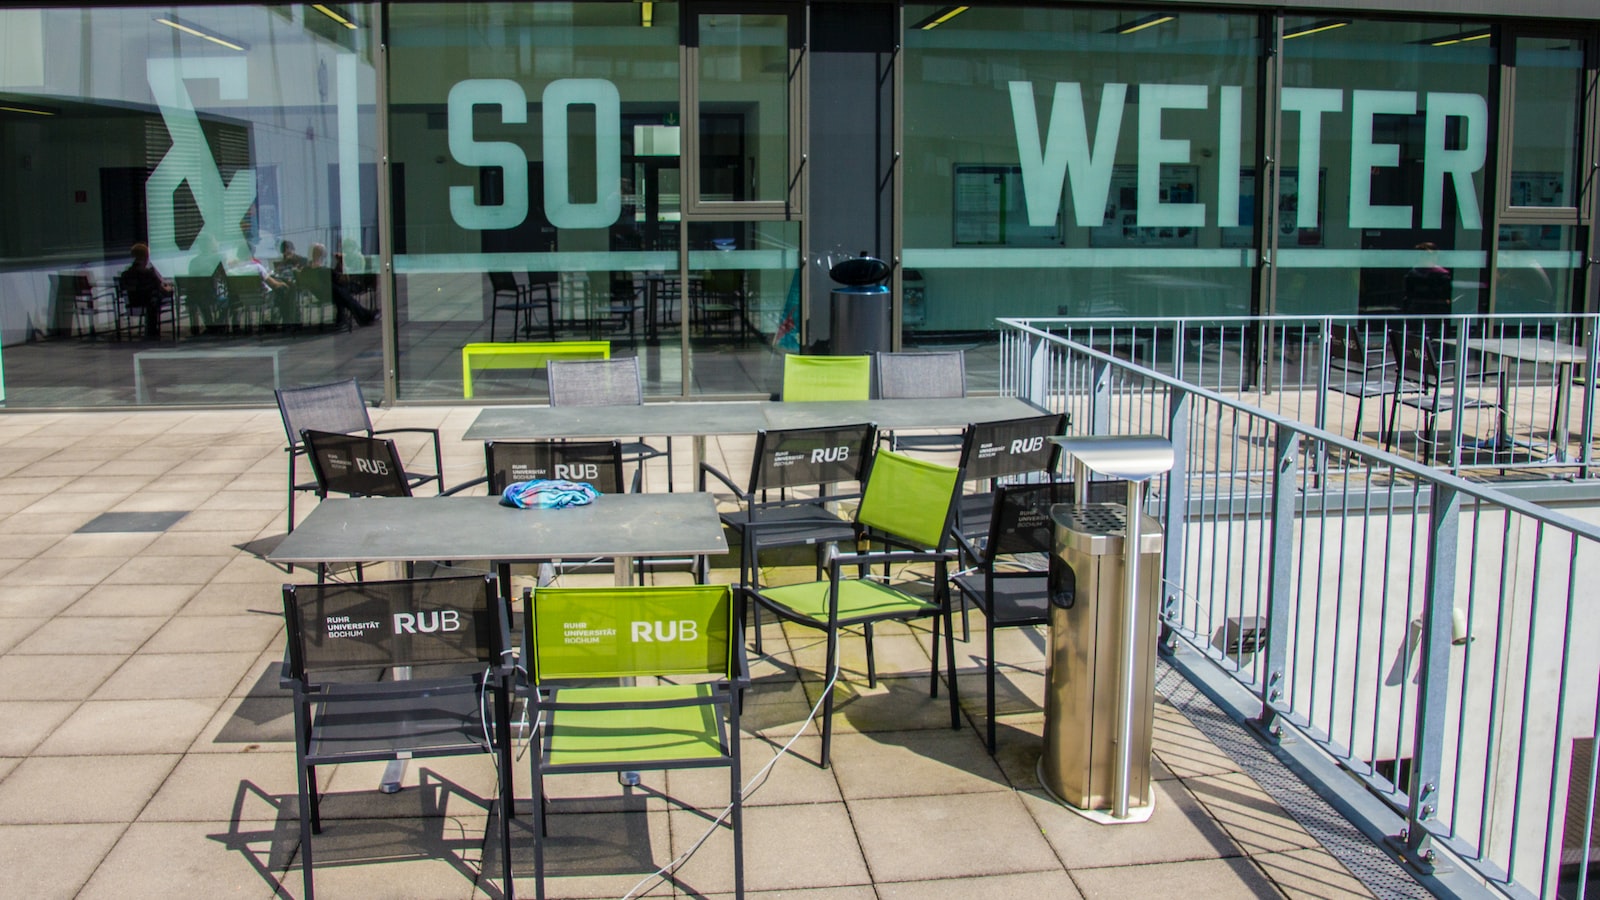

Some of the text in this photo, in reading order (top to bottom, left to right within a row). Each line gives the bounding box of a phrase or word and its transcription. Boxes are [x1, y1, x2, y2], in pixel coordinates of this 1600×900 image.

[448, 78, 621, 230] SO
[1008, 80, 1489, 230] WEITER
[1010, 436, 1044, 455] RUB
[810, 446, 850, 464] RUB
[355, 457, 389, 476] RUB
[554, 463, 599, 480] RUB
[326, 616, 350, 624] RUHR
[327, 621, 380, 631] UNIVERSITÄT
[393, 610, 460, 634] RUB
[328, 630, 364, 638] BOCHUM
[564, 628, 617, 636] UNIVERSITÄT
[631, 619, 699, 643] RUB
[564, 636, 600, 644] BOCHUM
